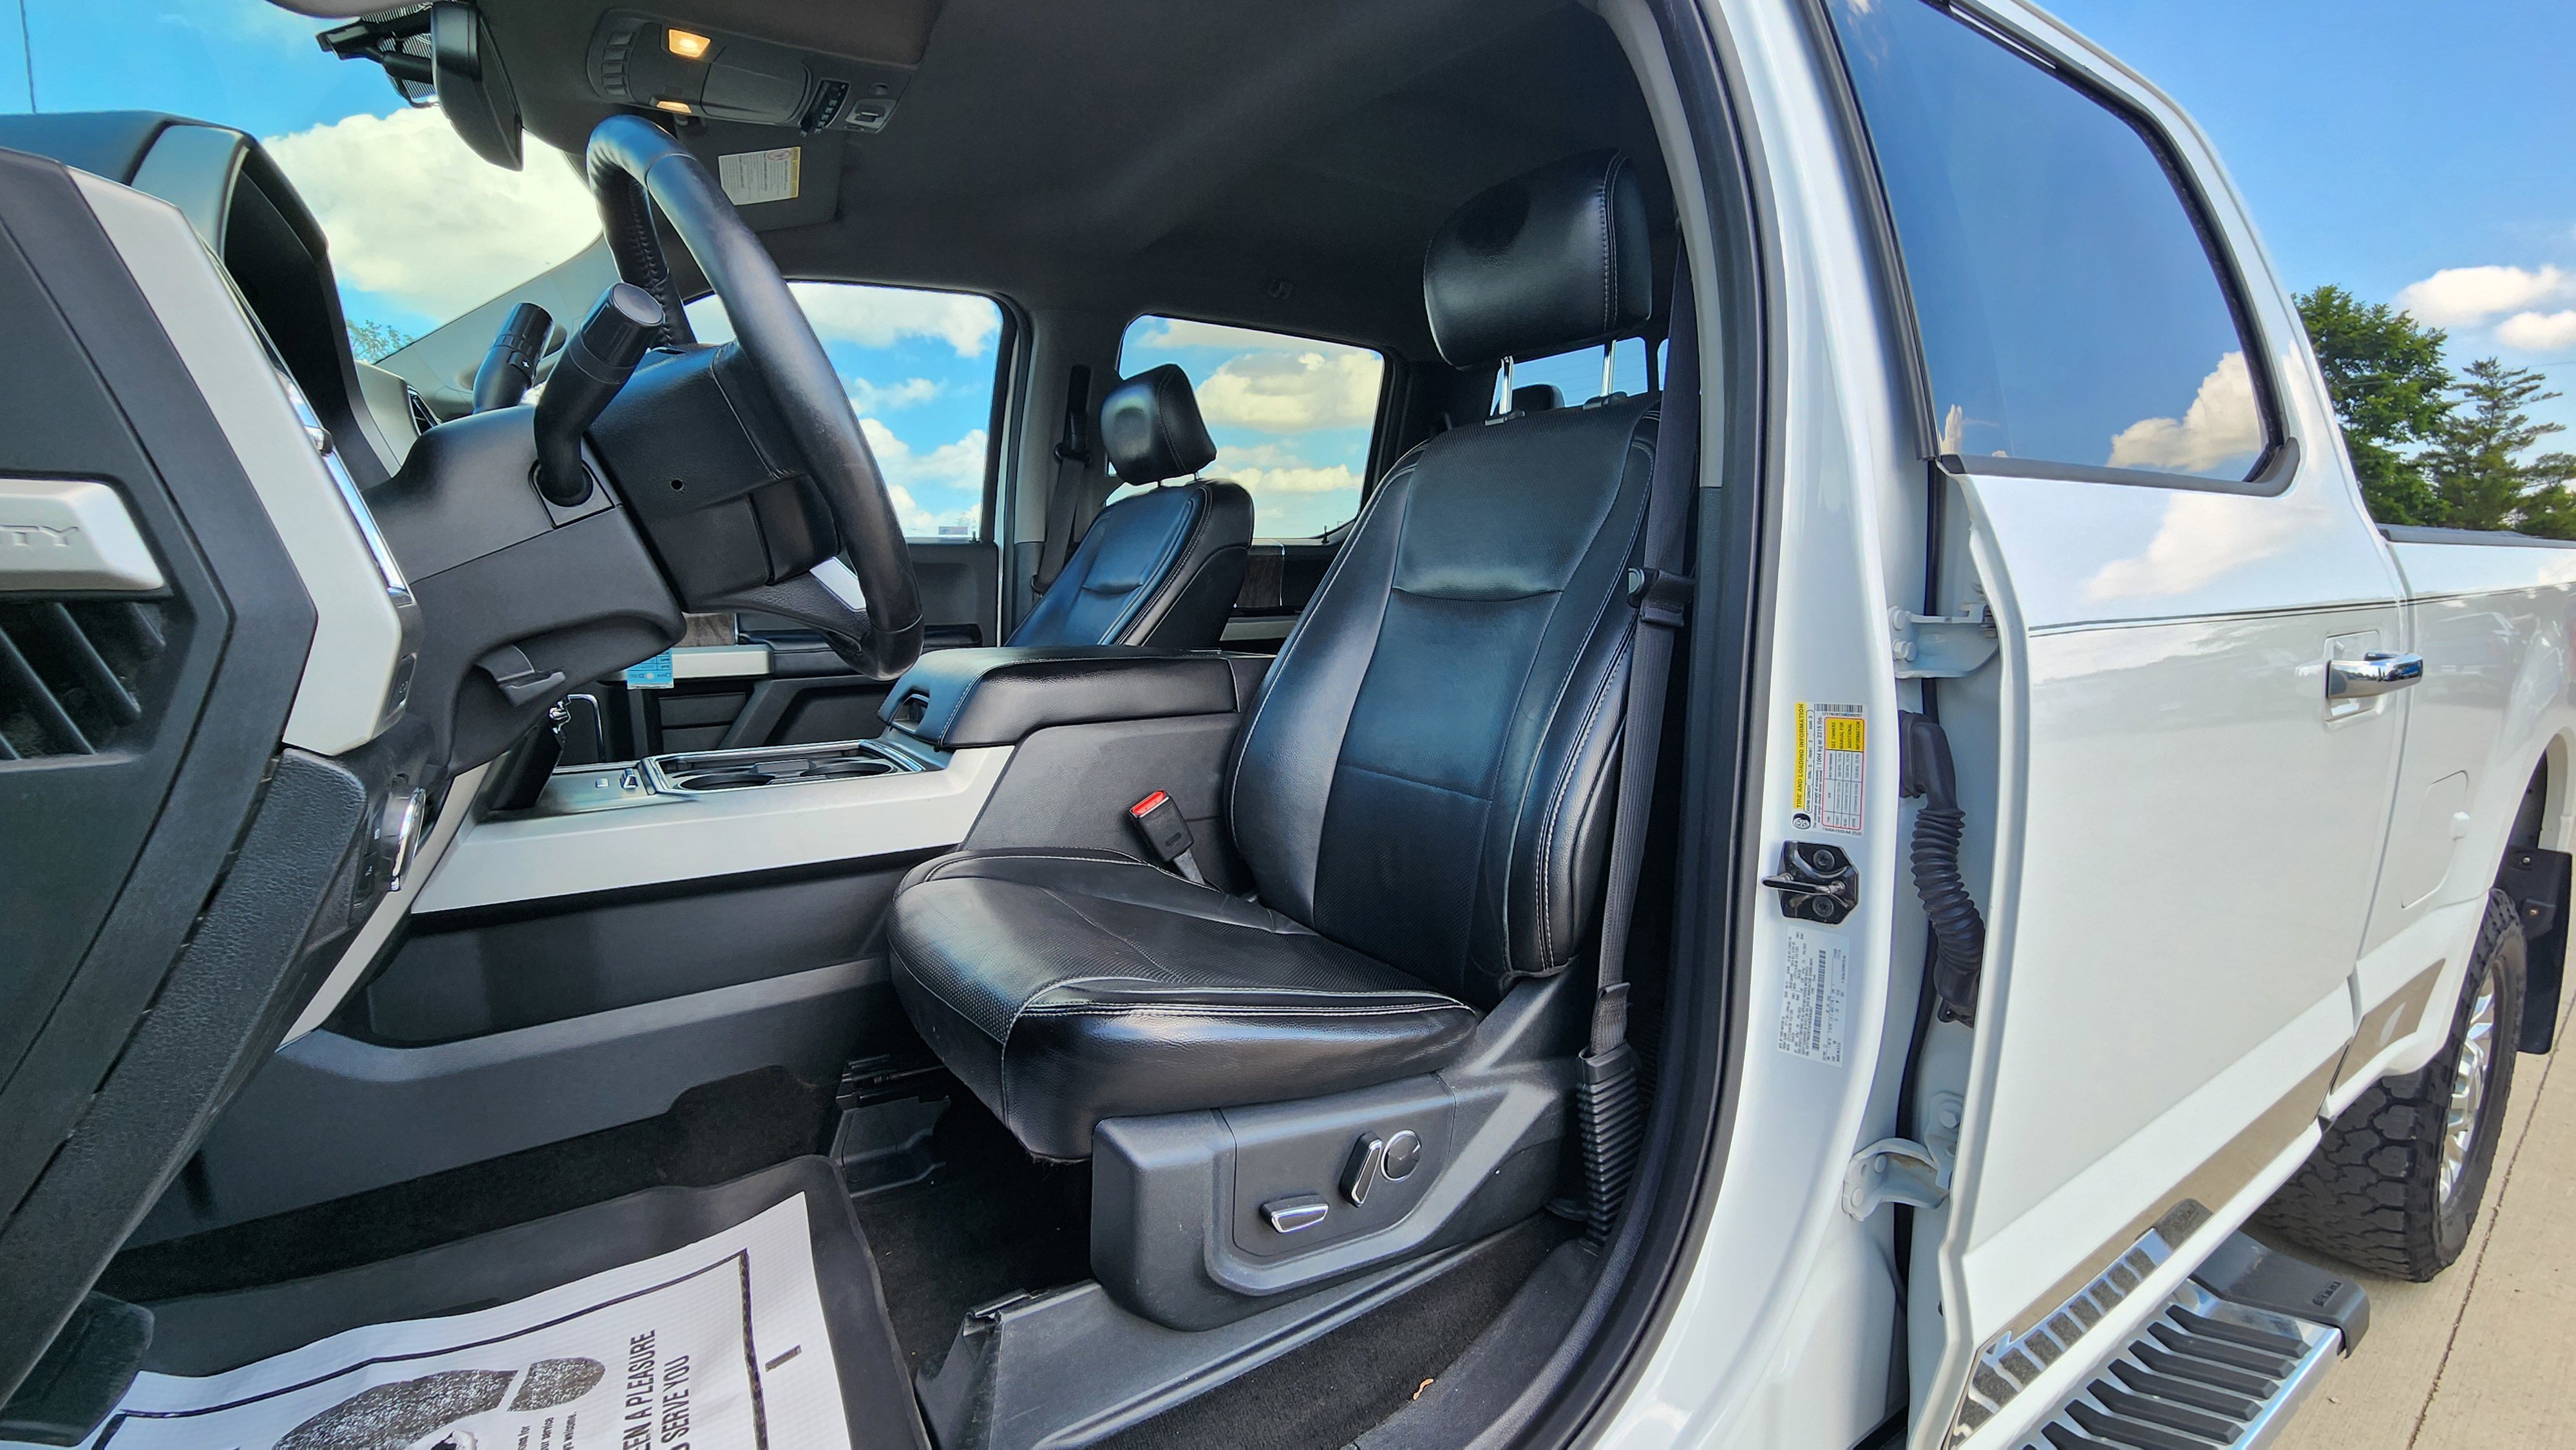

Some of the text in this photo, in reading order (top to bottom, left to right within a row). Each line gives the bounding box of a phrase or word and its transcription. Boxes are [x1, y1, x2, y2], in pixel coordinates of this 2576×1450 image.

[625, 1329, 656, 1408] PLEASURE
[663, 1355, 690, 1393] YOU
[541, 1417, 554, 1440] service
[563, 1411, 577, 1442] welcome.
[625, 1406, 652, 1420] A
[661, 1389, 690, 1444] SERVE
[518, 1426, 531, 1436] for
